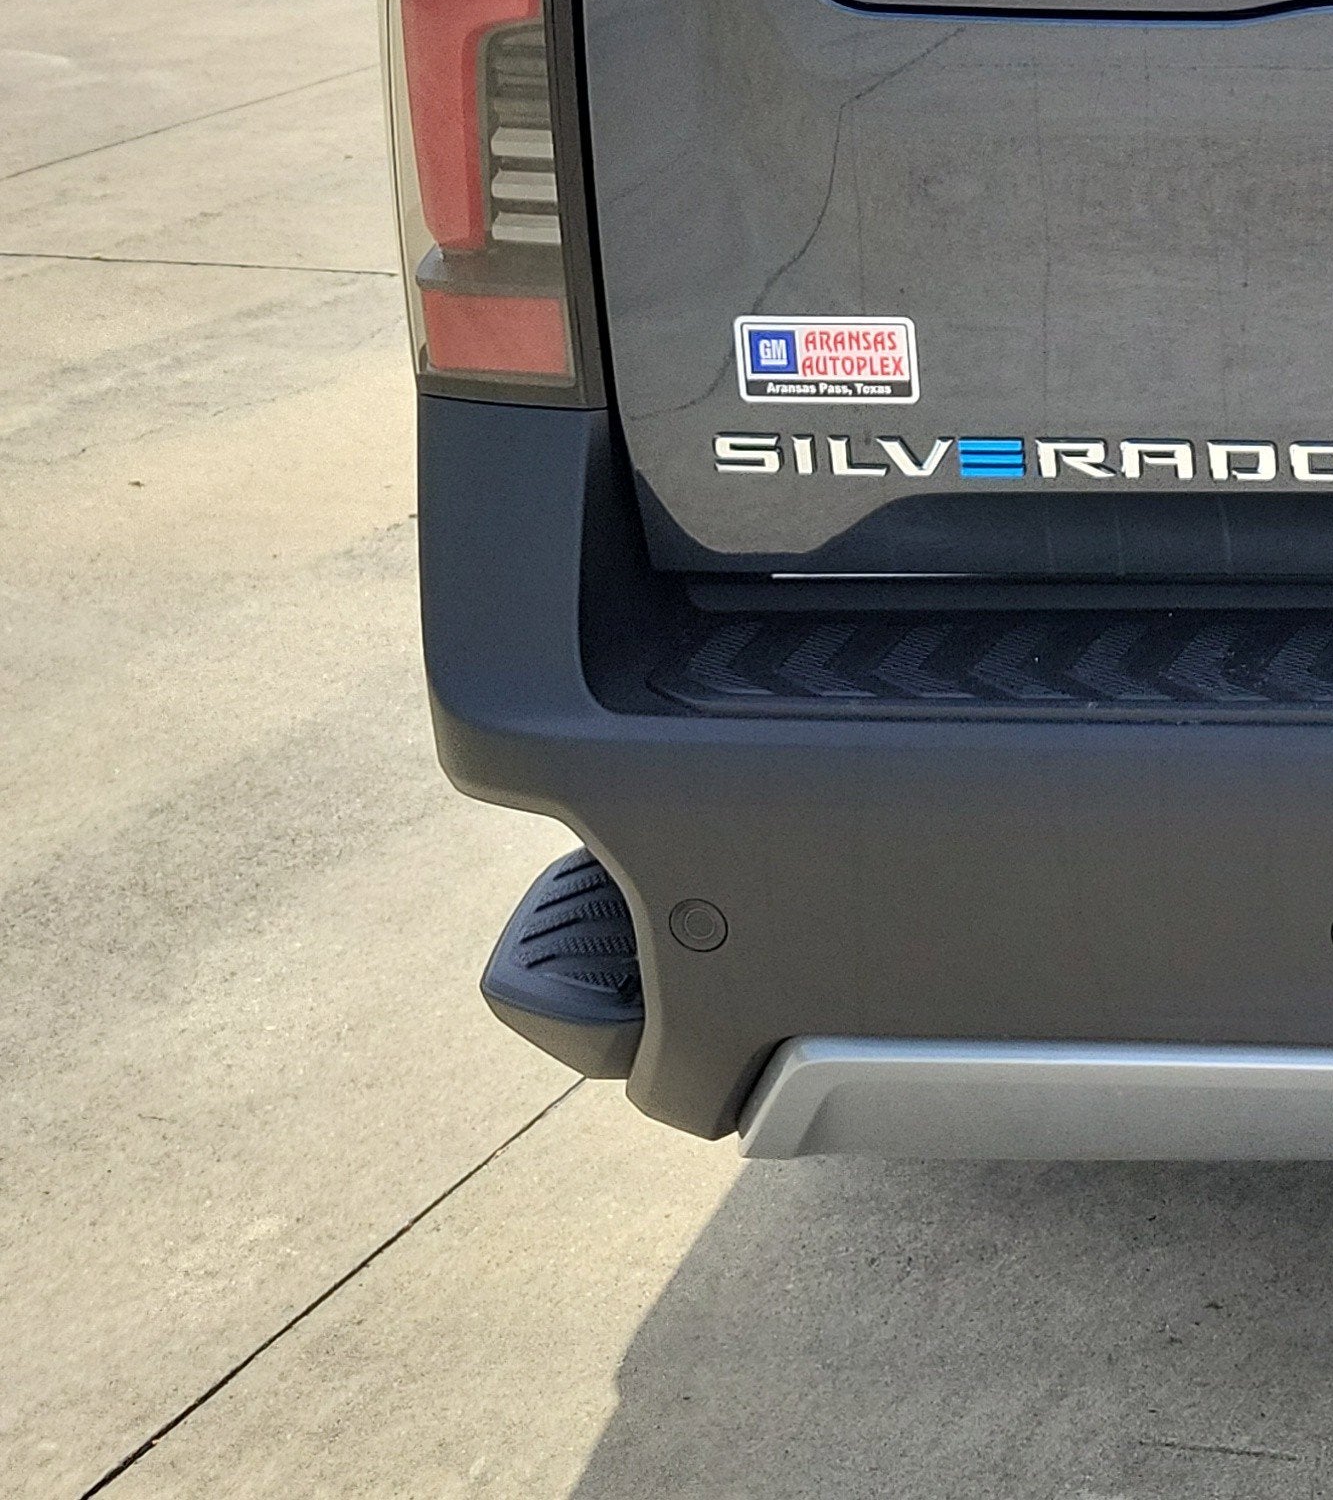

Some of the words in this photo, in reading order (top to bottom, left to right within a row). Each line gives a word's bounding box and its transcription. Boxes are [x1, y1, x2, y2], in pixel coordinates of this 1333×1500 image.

[758, 338, 788, 361] GM
[804, 330, 897, 353] ARANSAS
[801, 356, 905, 377] AUTOPLEX
[766, 381, 817, 395] Aransas
[818, 382, 853, 396] Pass,
[855, 382, 892, 395] Texas
